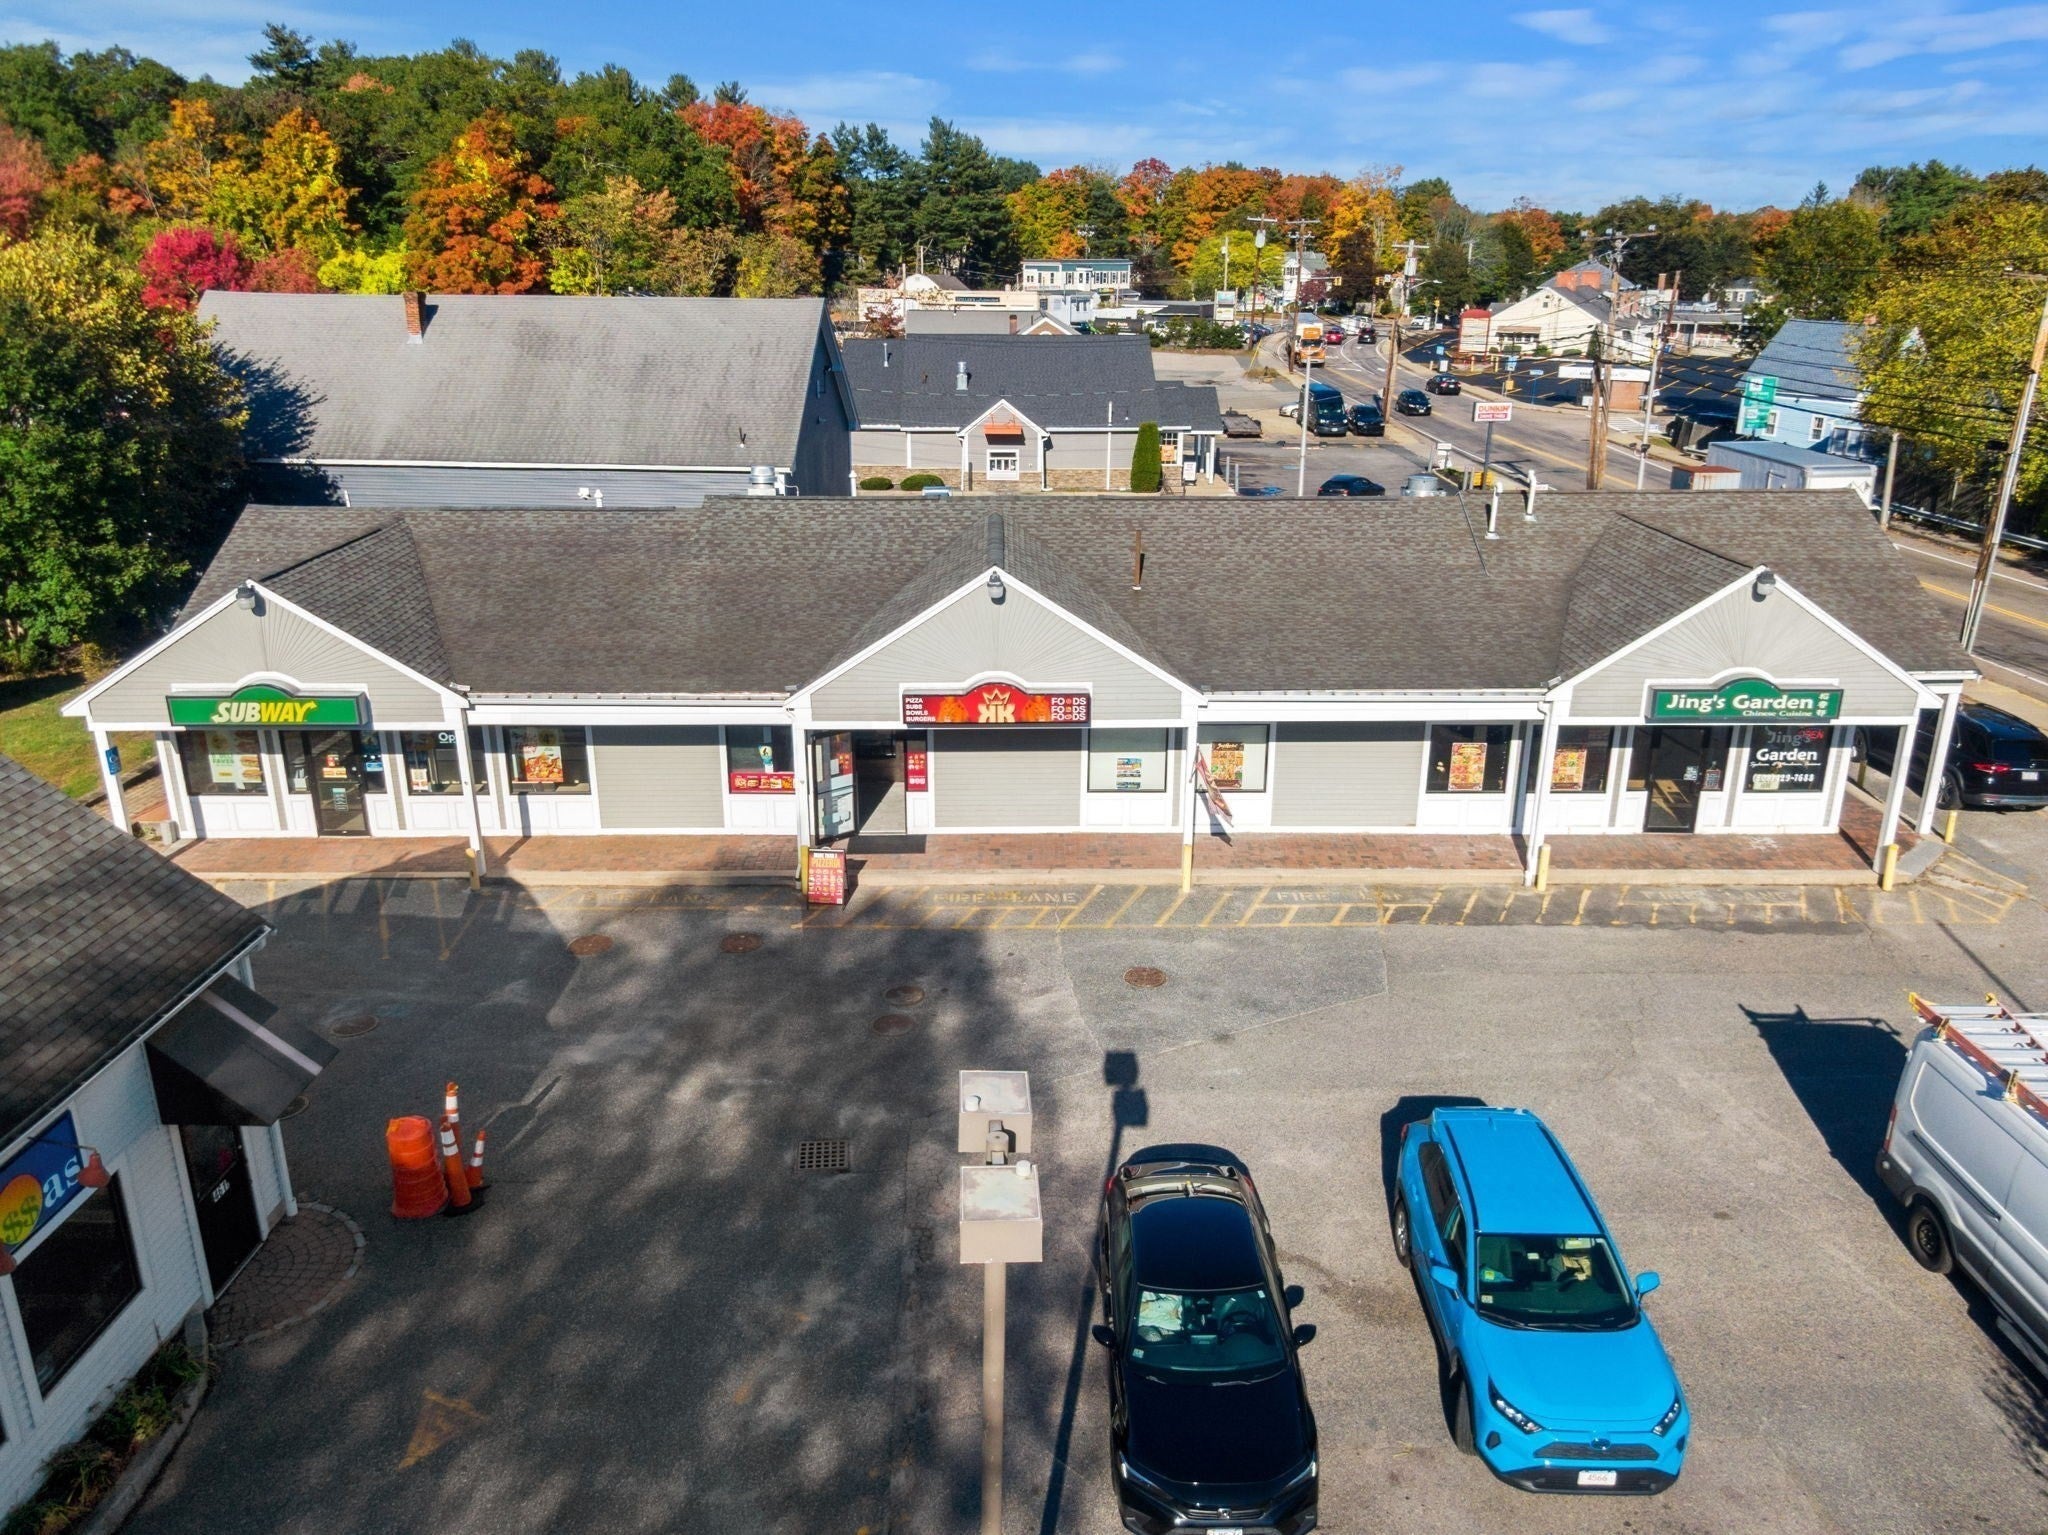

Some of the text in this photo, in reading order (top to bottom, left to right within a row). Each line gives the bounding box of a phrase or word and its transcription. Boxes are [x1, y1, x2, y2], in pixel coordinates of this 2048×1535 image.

[211, 700, 318, 723] SUBWAY
[1666, 694, 1726, 712] Jing's
[1732, 694, 1813, 709] Garden
[1756, 748, 1818, 761] Garden
